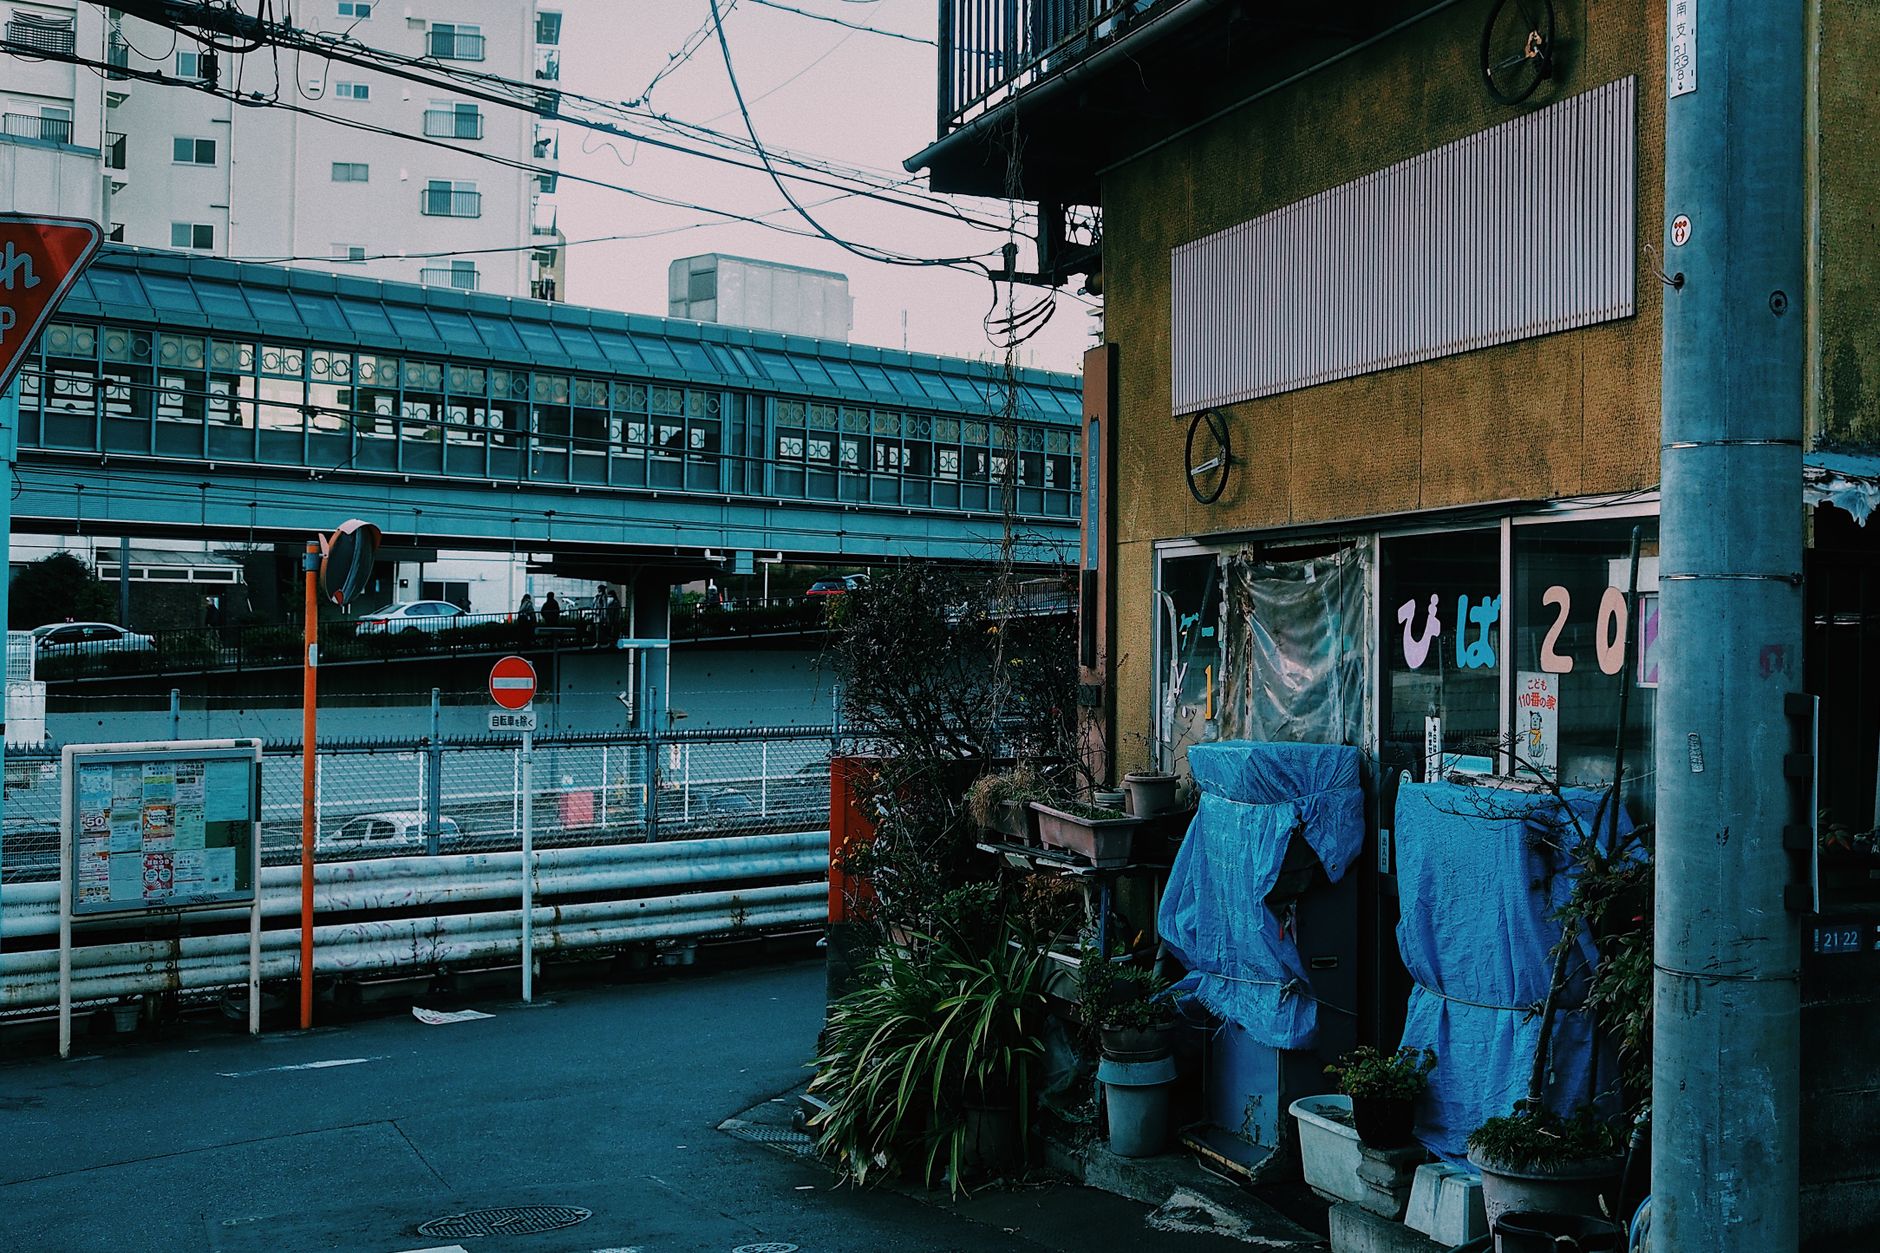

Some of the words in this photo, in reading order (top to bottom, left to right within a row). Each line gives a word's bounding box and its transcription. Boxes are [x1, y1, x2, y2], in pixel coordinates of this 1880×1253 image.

[1527, 678, 1548, 691] こども
[1518, 691, 1557, 711] 110番の家
[492, 714, 533, 727] 自転車を除く
